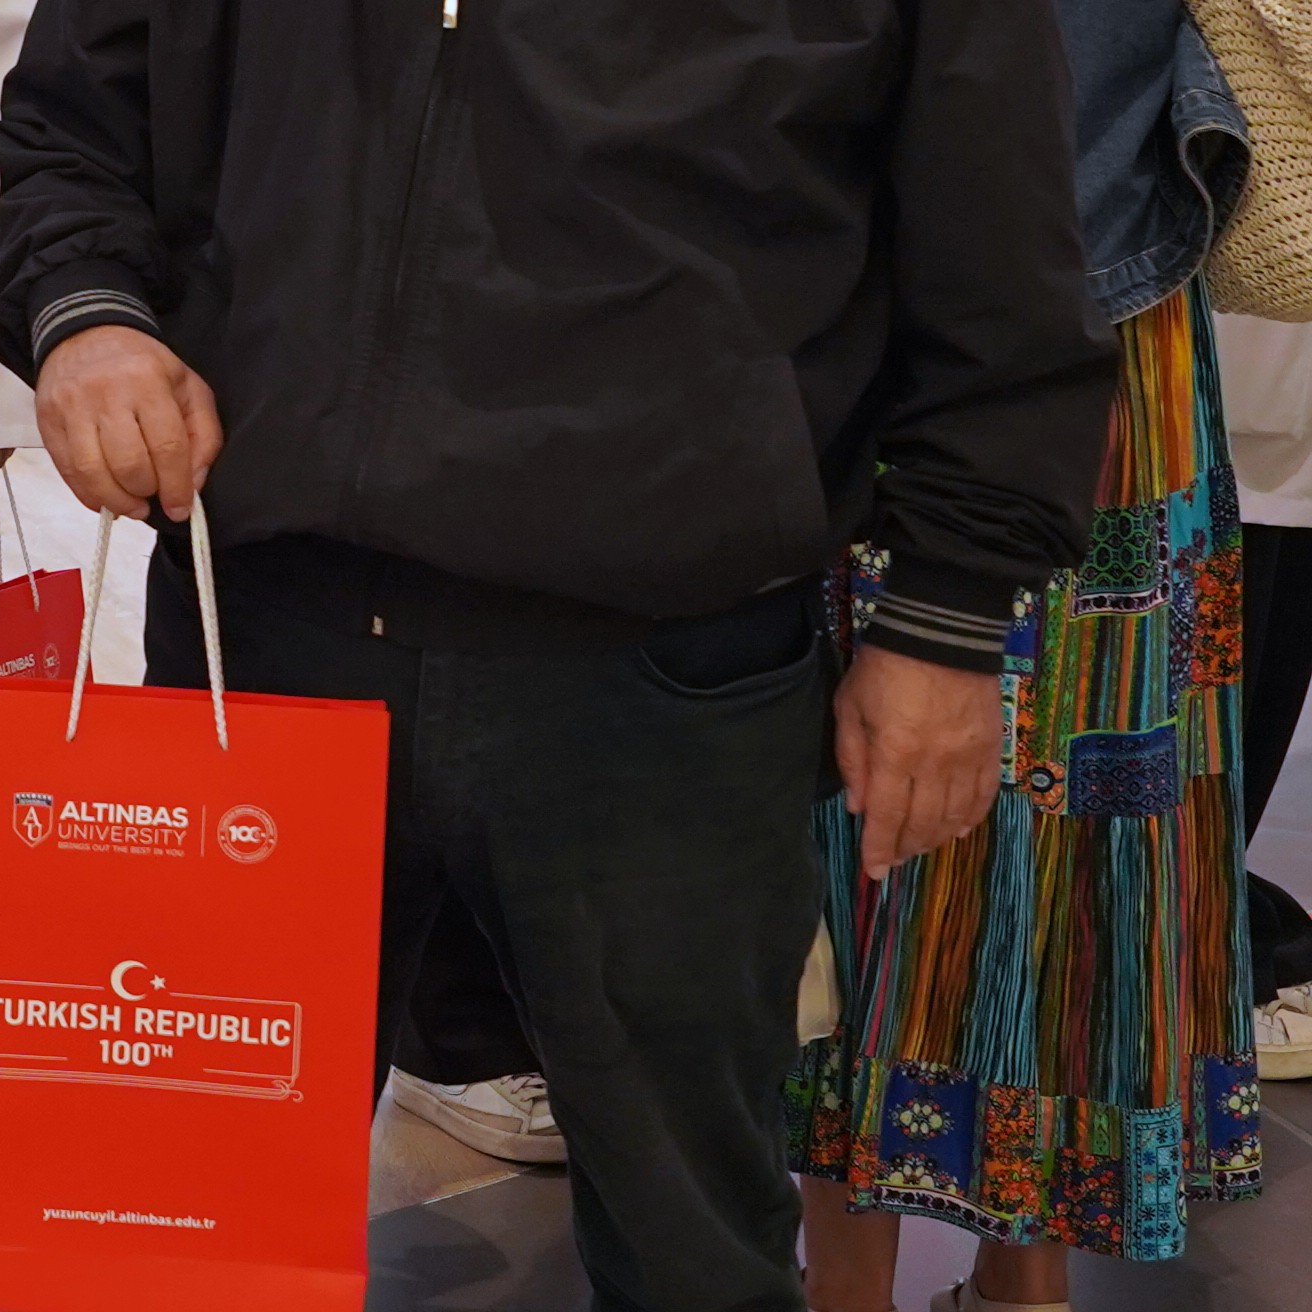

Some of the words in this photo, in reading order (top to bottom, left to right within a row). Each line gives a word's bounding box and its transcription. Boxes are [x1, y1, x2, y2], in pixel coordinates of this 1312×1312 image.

[57, 822, 187, 846] UNIVERSITY
[133, 1006, 292, 1047] REPUBLIC
[42, 1207, 217, 1230] yuzuncuyil.altinbas.edu.tr
